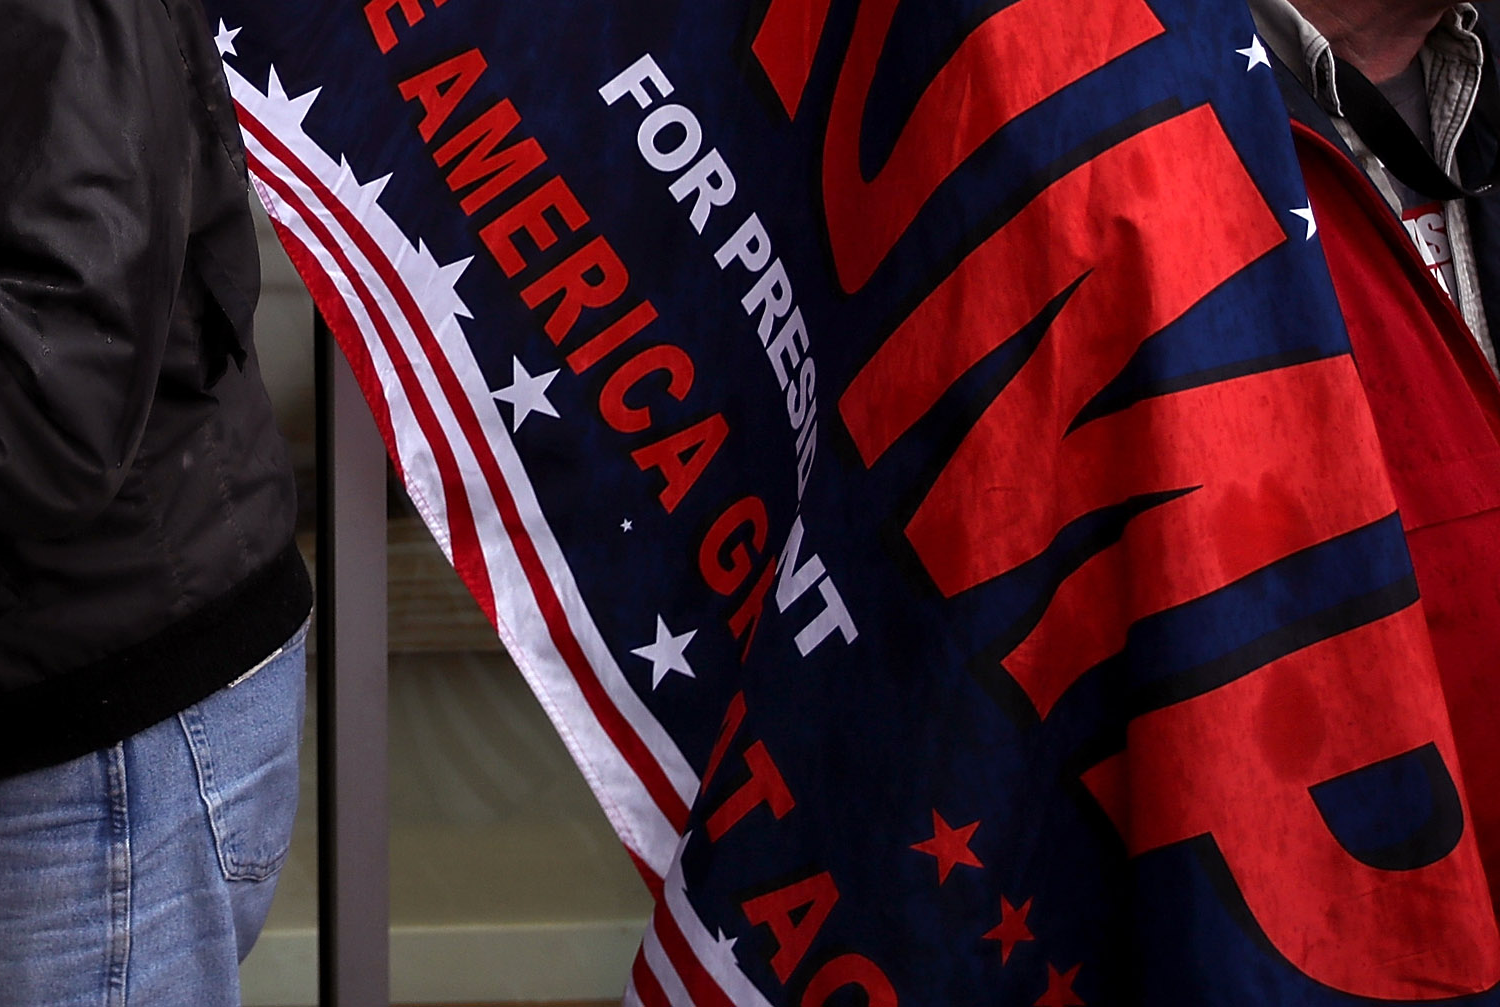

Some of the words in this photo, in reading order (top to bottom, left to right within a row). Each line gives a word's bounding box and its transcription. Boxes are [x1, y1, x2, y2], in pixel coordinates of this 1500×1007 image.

[398, 47, 730, 514] AMERICA
[598, 53, 737, 236] FOR
[713, 211, 859, 658] PRESIDNT
